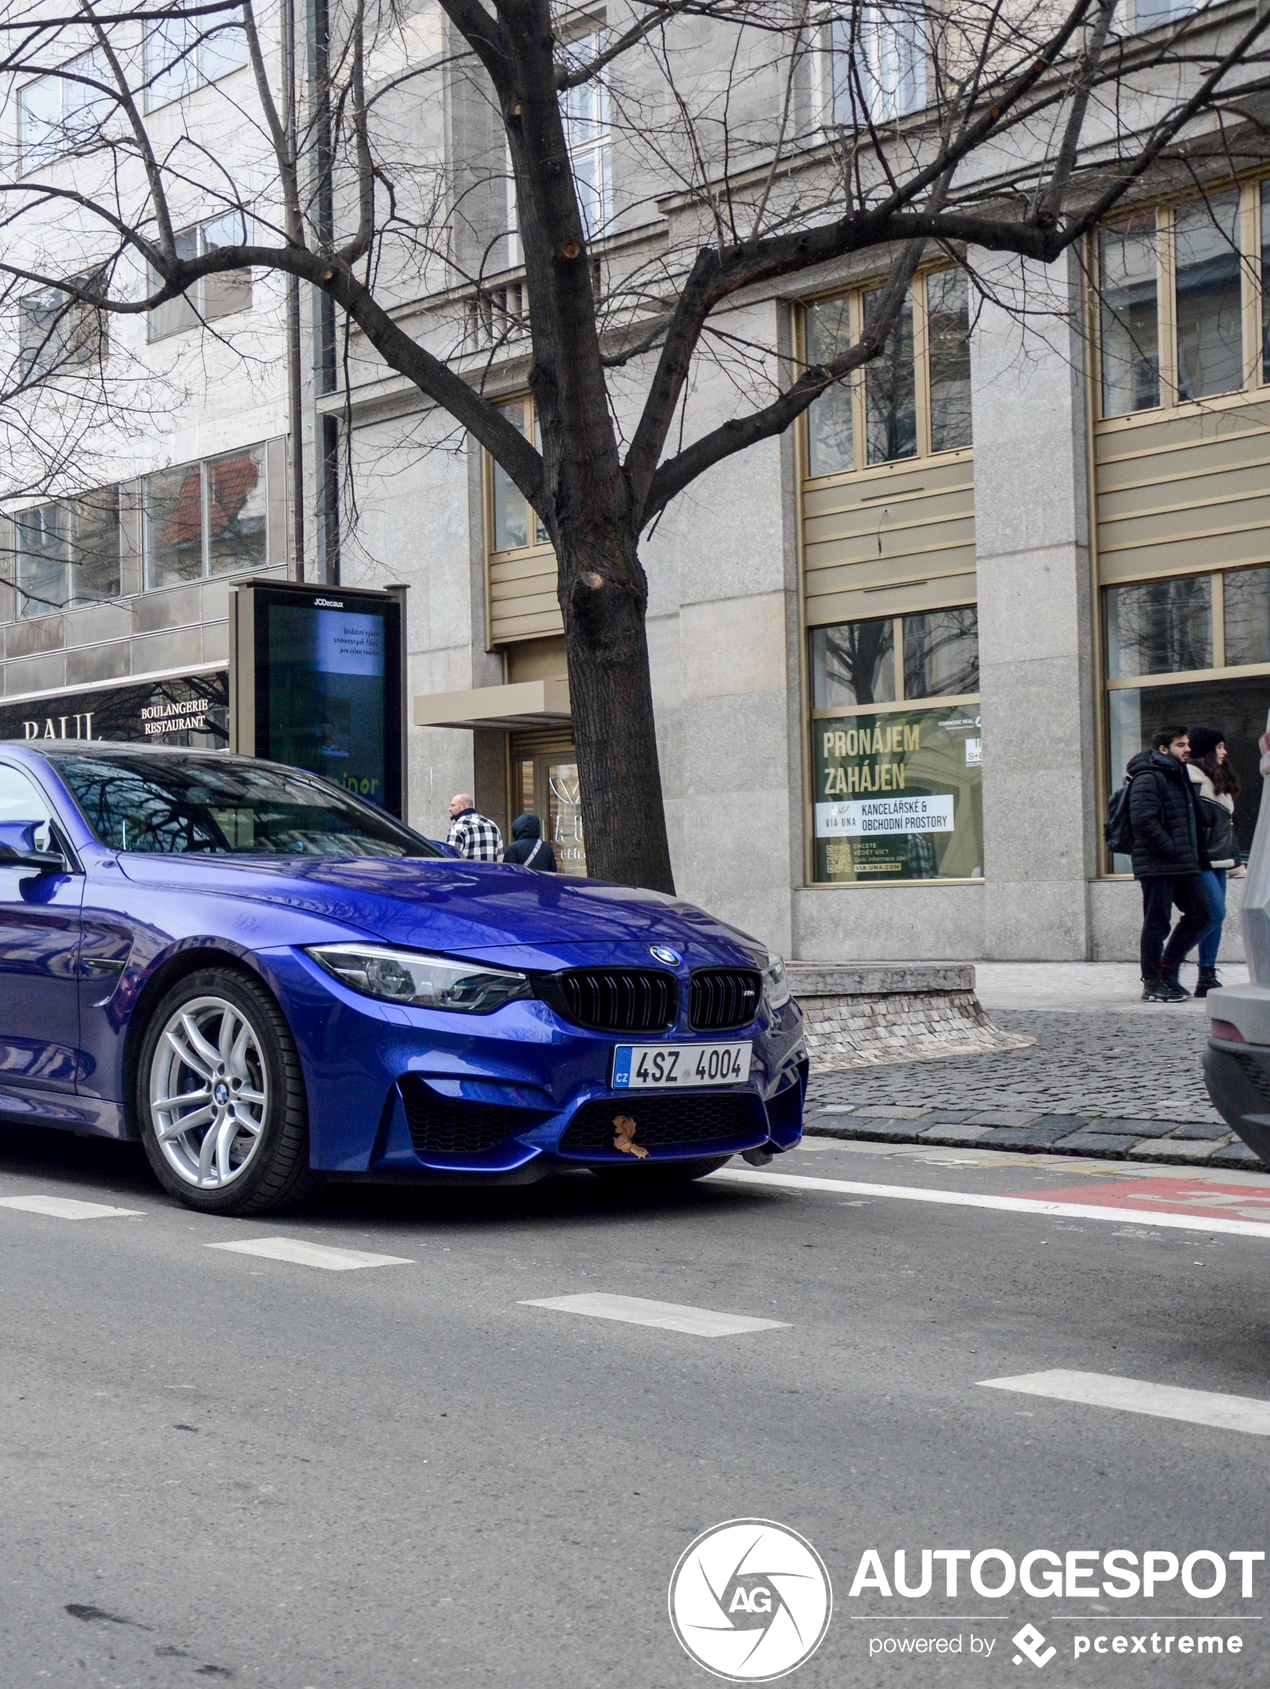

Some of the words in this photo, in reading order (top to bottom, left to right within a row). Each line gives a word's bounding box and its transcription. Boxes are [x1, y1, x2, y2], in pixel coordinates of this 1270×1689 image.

[314, 598, 344, 608] JCDecaux
[141, 699, 209, 720] BOULANGERIE
[144, 715, 206, 735] RESTAURANT
[823, 722, 920, 758] PRONÁJEM
[824, 760, 905, 794] ZAHÁJEN
[861, 799, 919, 816] KANCELÁŘSKÉ
[921, 801, 927, 813] &
[825, 819, 838, 828] VIA
[841, 818, 857, 827] UNA
[862, 815, 903, 831] OBCHODNÍ
[905, 815, 948, 829] PROSTORY
[636, 1051, 679, 1083] 4SZ
[695, 1048, 741, 1080] 4004
[616, 1072, 628, 1083] CZ
